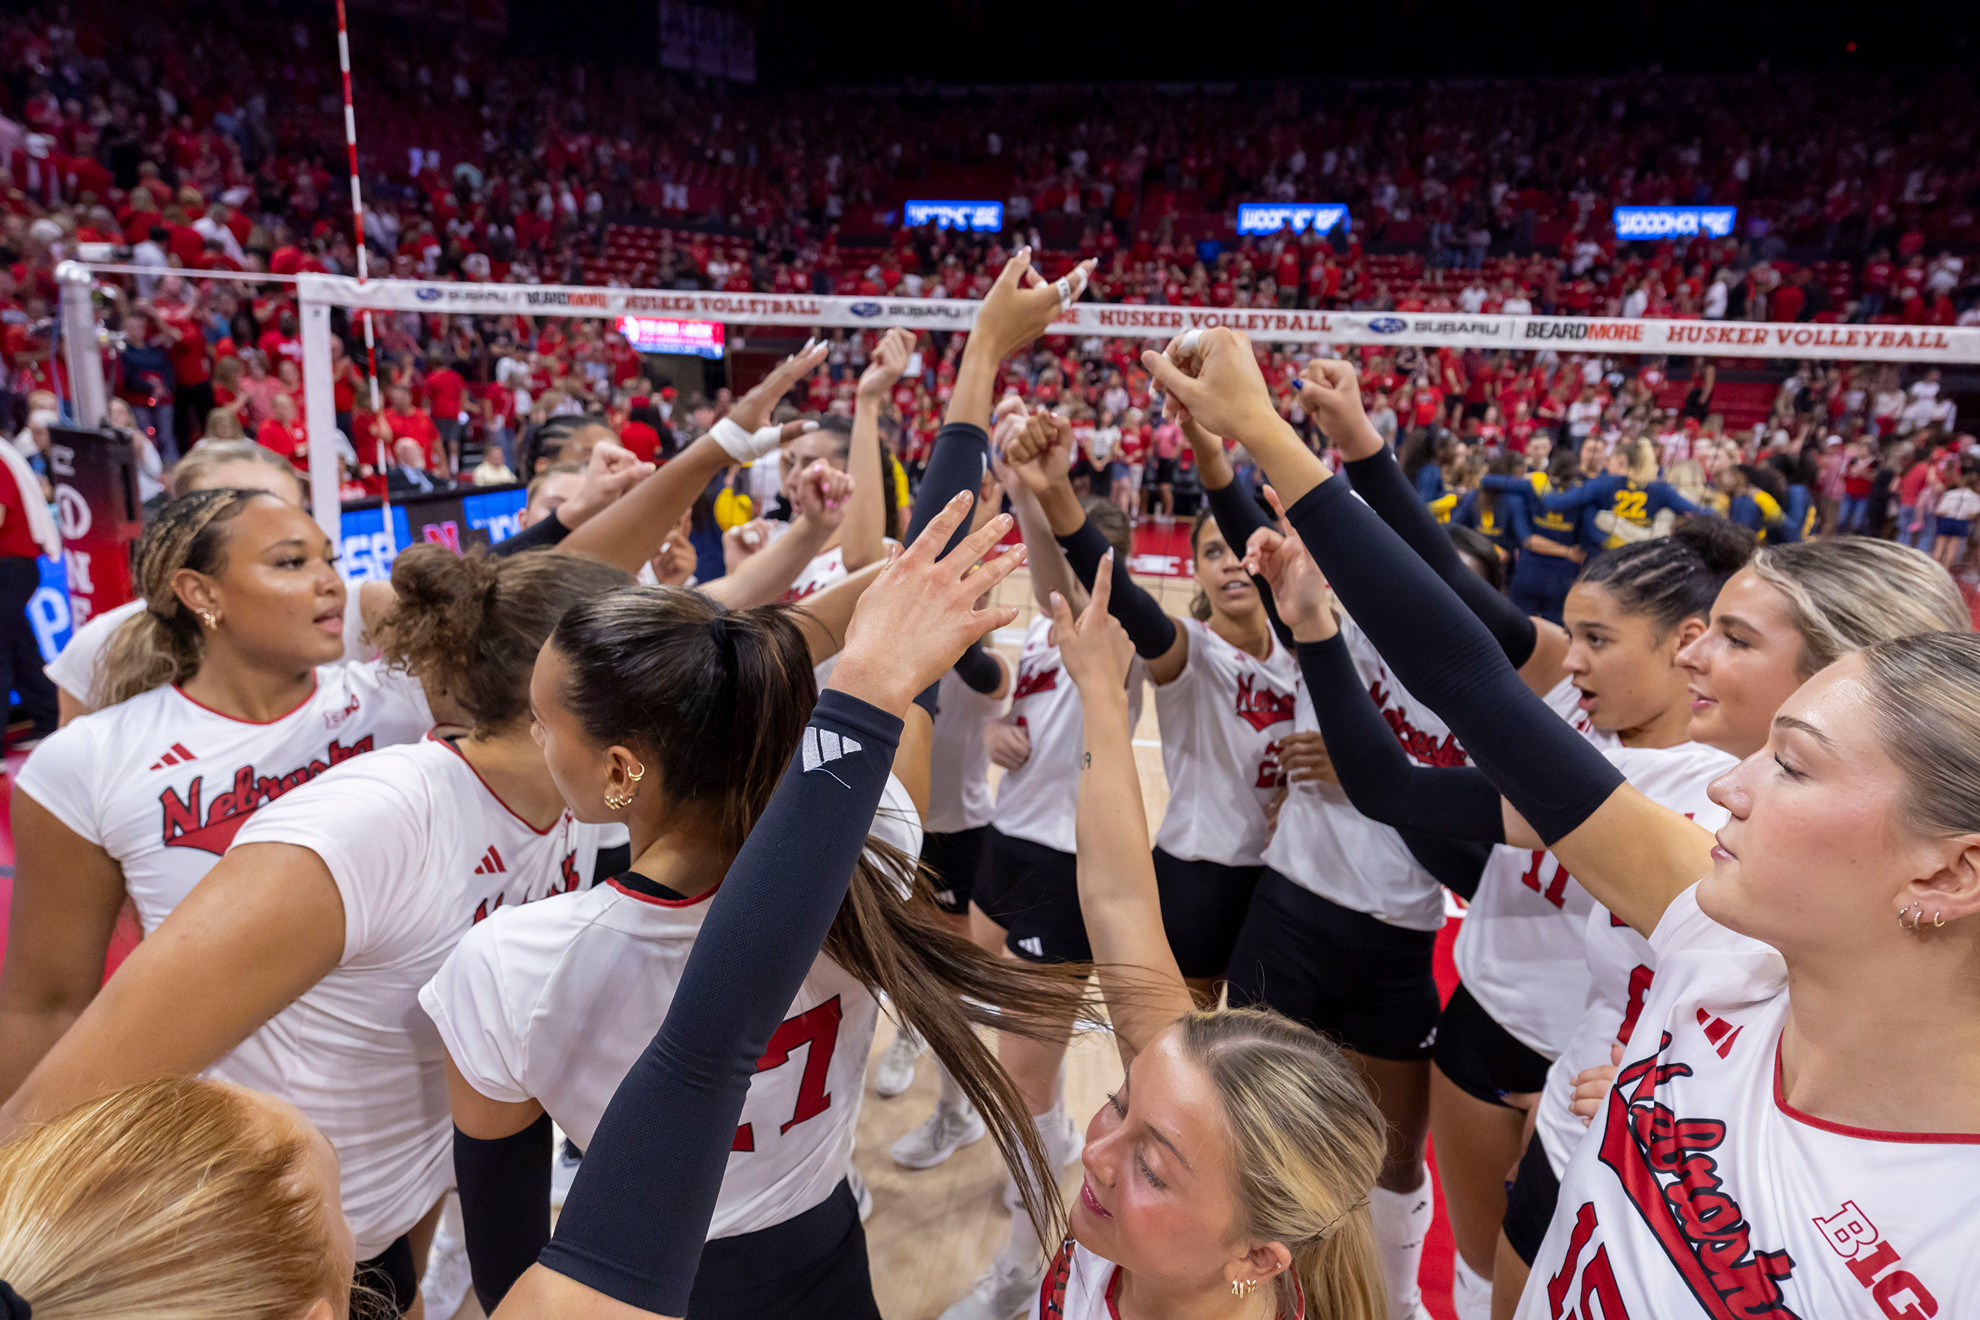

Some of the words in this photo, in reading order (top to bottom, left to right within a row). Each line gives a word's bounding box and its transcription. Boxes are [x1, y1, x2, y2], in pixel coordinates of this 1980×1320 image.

[625, 295, 695, 311] HUSKER
[701, 297, 821, 316] VOLLEYBALL
[889, 305, 960, 319] SUBARU
[1099, 310, 1183, 328] HUSKER
[1189, 312, 1333, 332] VOLLEYBALL
[1413, 321, 1500, 336] SUBARU
[1524, 321, 1646, 342] BEARDMORE
[1666, 325, 1769, 345] HUSKER
[1775, 328, 1950, 350] VOLLEYBALL
[1613, 490, 1649, 519] 22
[731, 993, 843, 1152] 7
[1600, 1030, 1805, 1320] Nebrask
